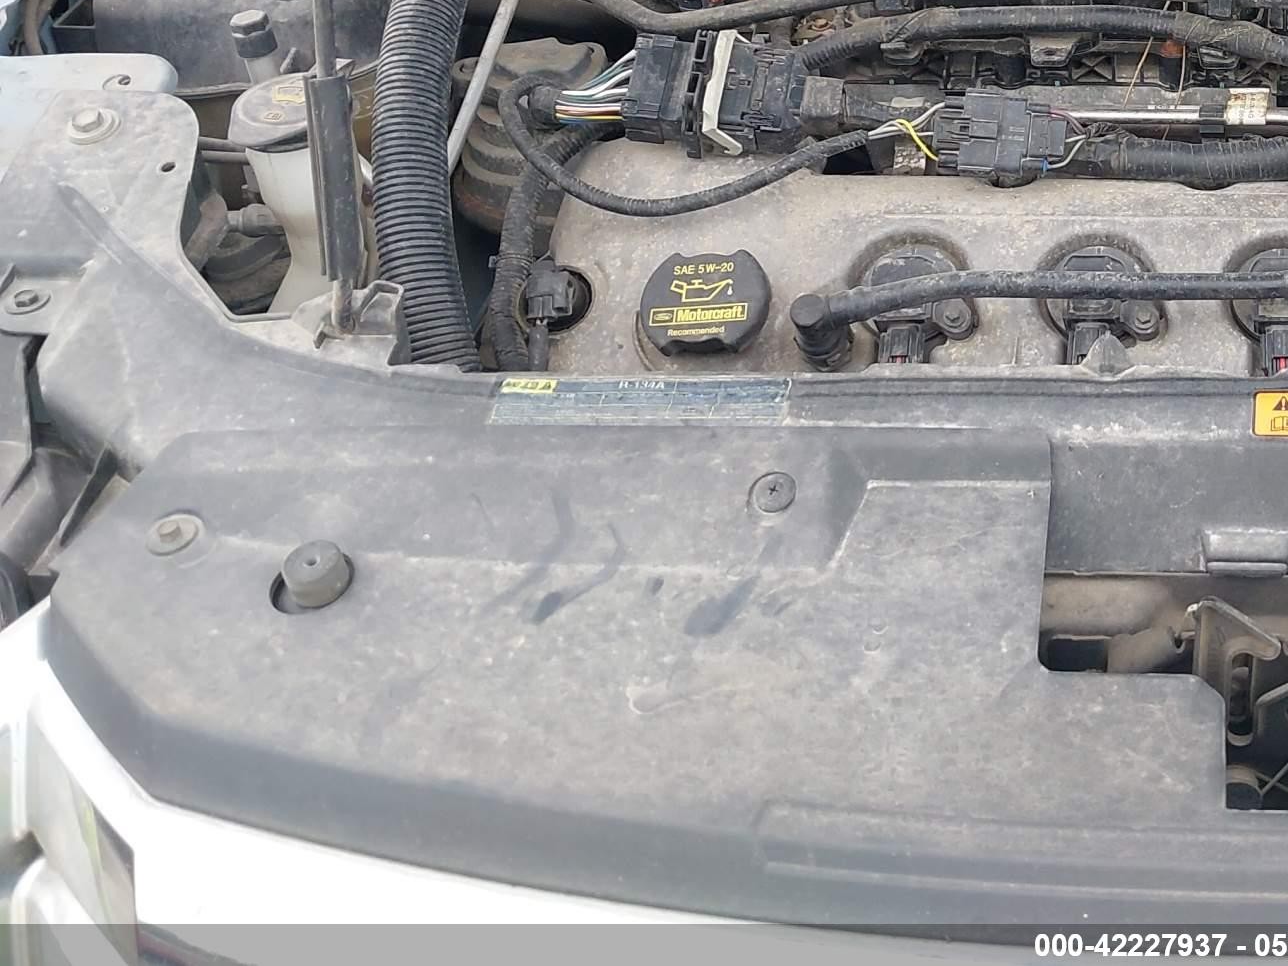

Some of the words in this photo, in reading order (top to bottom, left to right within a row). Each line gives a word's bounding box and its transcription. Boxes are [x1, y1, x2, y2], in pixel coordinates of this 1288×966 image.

[674, 264, 695, 275] SAE
[698, 263, 734, 274] 5W-20
[667, 326, 725, 336] Recommended
